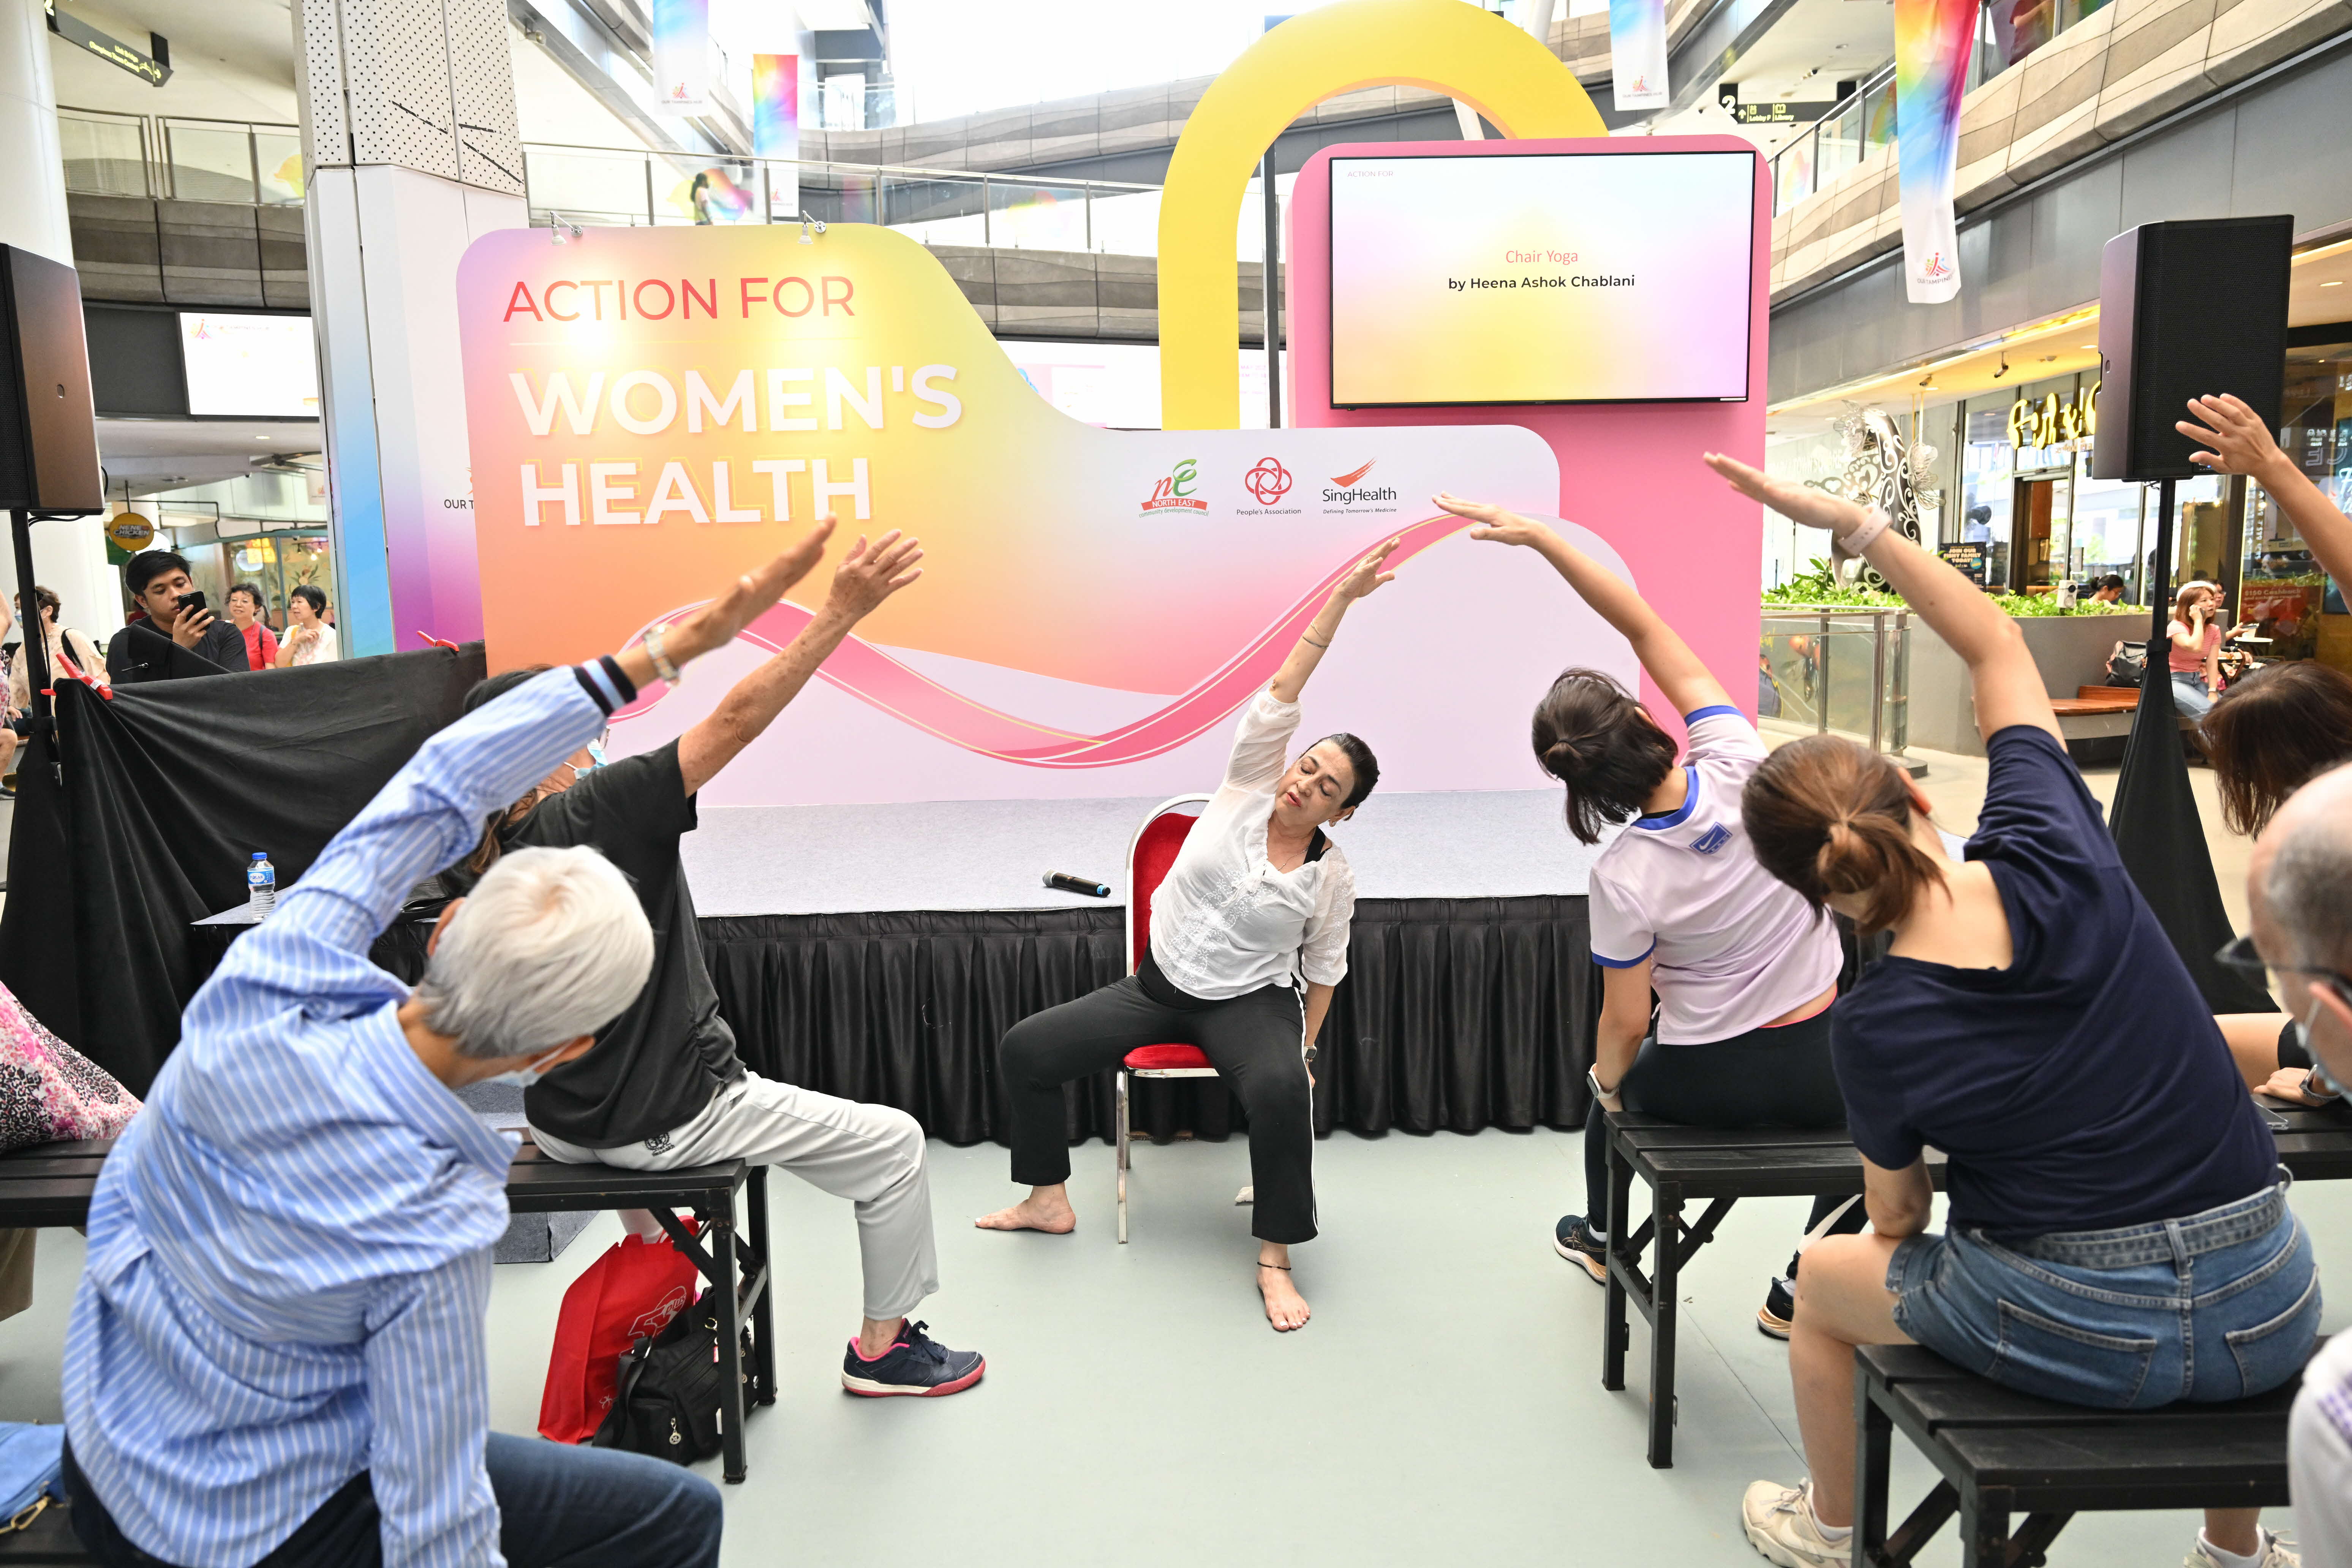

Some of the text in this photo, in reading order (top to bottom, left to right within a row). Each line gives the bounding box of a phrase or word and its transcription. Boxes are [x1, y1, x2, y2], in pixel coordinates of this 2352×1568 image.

[1721, 95, 1736, 114] 2
[1506, 250, 1578, 265] Chair Yoga
[1448, 274, 1635, 292] by Heena Ashok Chablani
[503, 276, 855, 322] ACTION FOR
[508, 364, 963, 436] WOMEN'S
[2006, 393, 2057, 450] Fish
[520, 457, 871, 526] HEALTH
[1323, 487, 1397, 504] SingHealth
[444, 499, 467, 509] OUR
[1152, 499, 1176, 508] NORTH
[1139, 509, 1163, 518] community
[666, 1293, 686, 1313] plus
